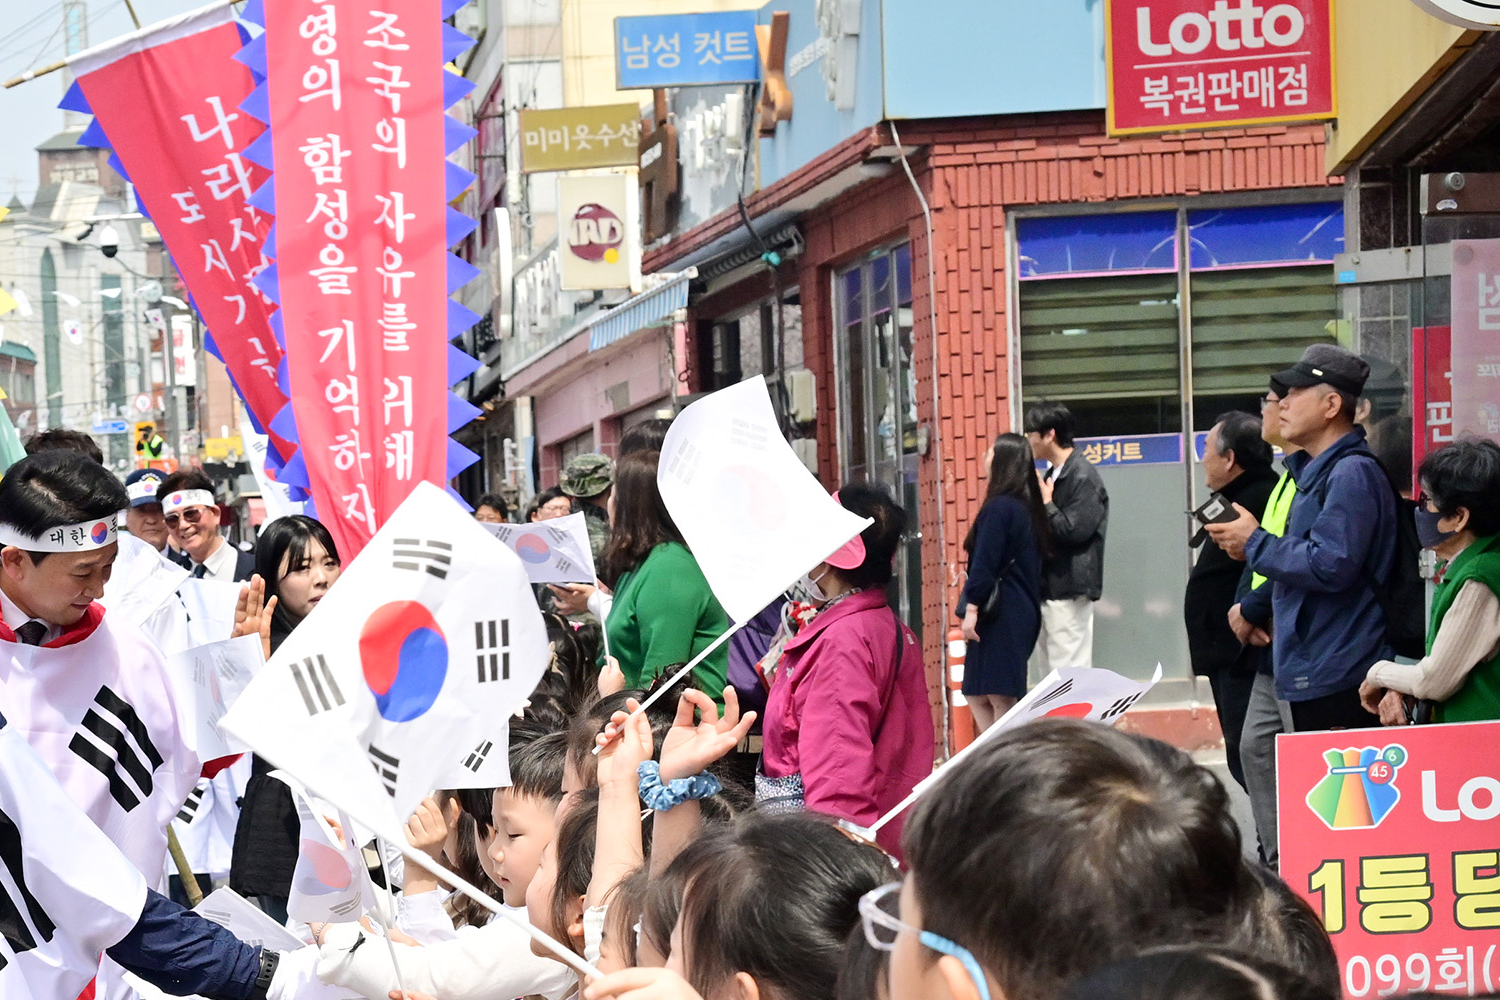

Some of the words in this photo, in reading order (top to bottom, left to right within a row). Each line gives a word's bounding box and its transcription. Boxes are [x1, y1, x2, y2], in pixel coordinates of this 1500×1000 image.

[622, 33, 681, 69] 남성
[693, 30, 754, 65] 컷트
[1136, 0, 1304, 56] Lotto
[299, 0, 341, 111] 영의
[363, 10, 411, 169] 조국의
[1140, 64, 1309, 116] 복권판매점
[525, 121, 640, 153] 미미옷수선
[299, 133, 358, 295] 함성을
[373, 191, 417, 351] 자유를
[317, 319, 377, 536] 기억하자
[382, 375, 414, 480] 위해
[50, 527, 87, 547] 대한
[1371, 765, 1388, 778] 45
[1389, 750, 1397, 762] 6
[1421, 770, 1500, 822] Lo
[1308, 853, 1434, 935] 1등
[1345, 944, 1500, 997] 099회(
